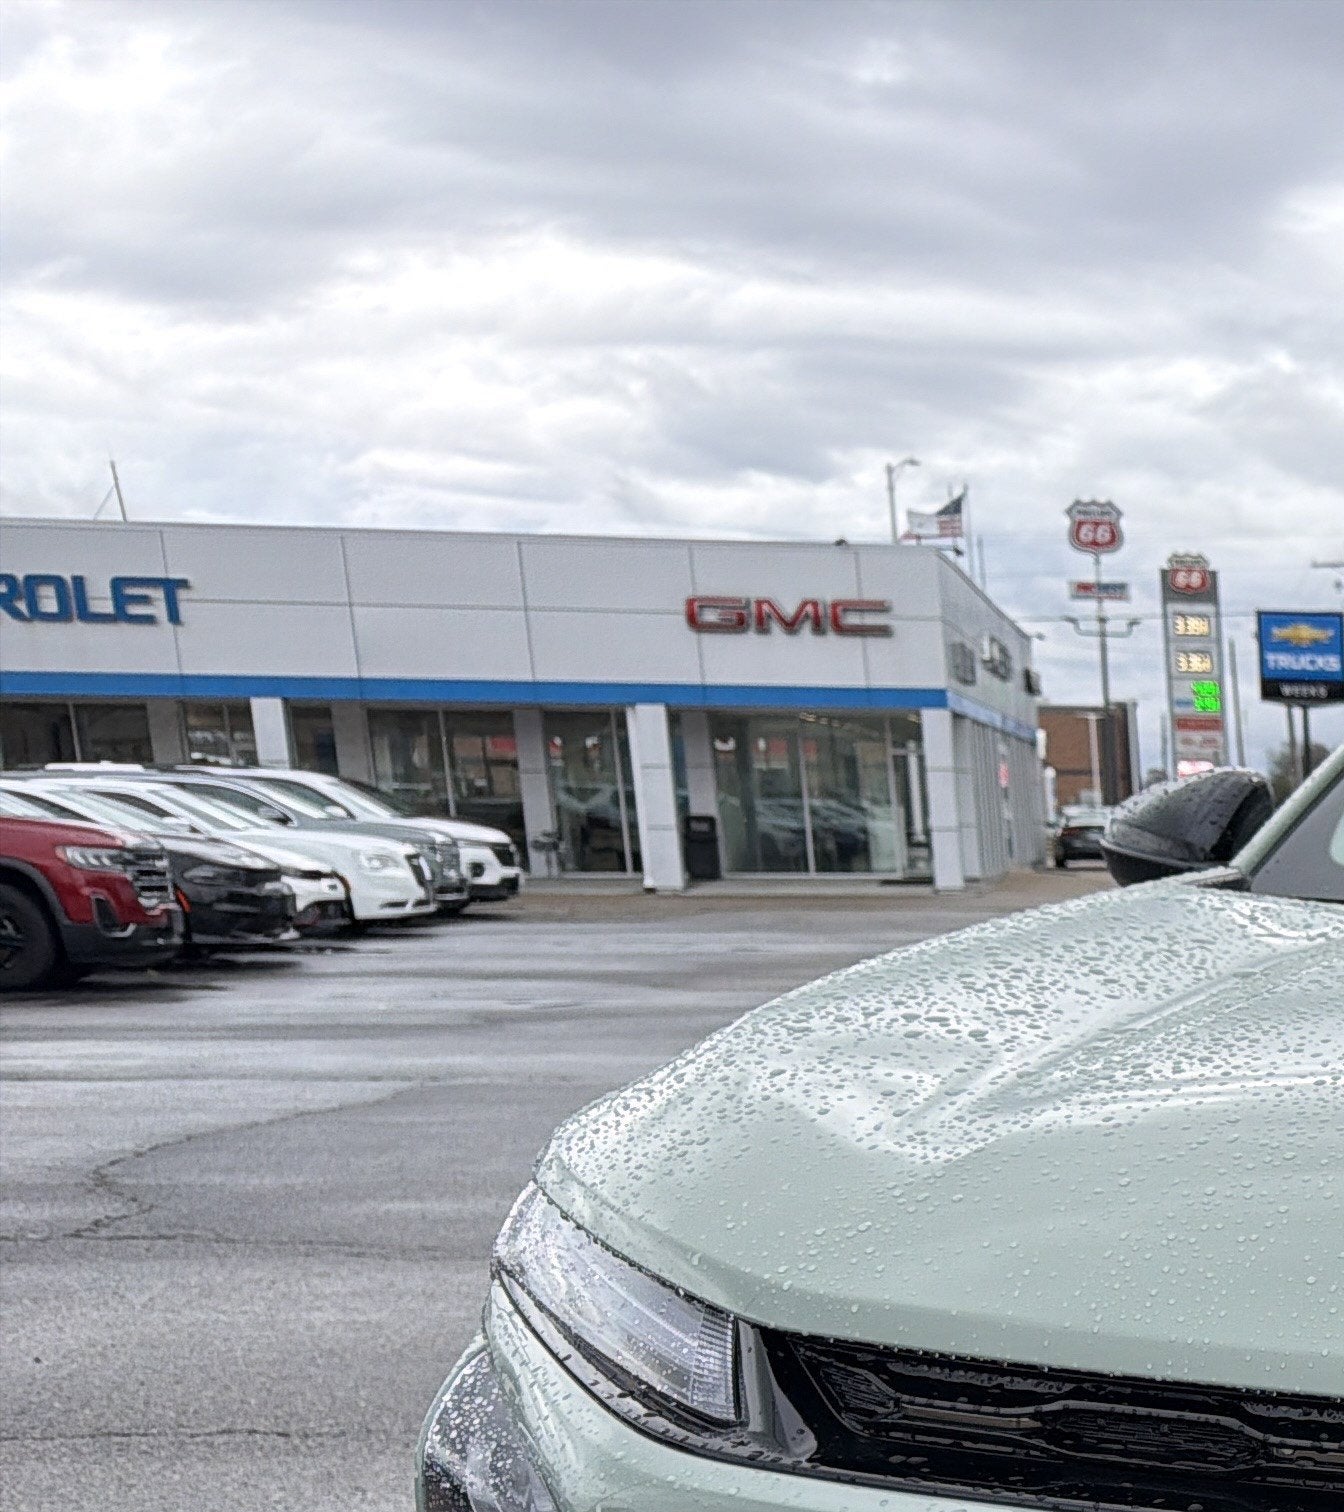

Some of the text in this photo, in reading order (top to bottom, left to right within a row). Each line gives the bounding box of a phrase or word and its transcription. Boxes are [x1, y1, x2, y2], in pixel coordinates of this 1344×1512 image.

[1079, 524, 1112, 545] 66
[684, 595, 893, 637] GMC
[1265, 652, 1341, 672] TRUCKS
